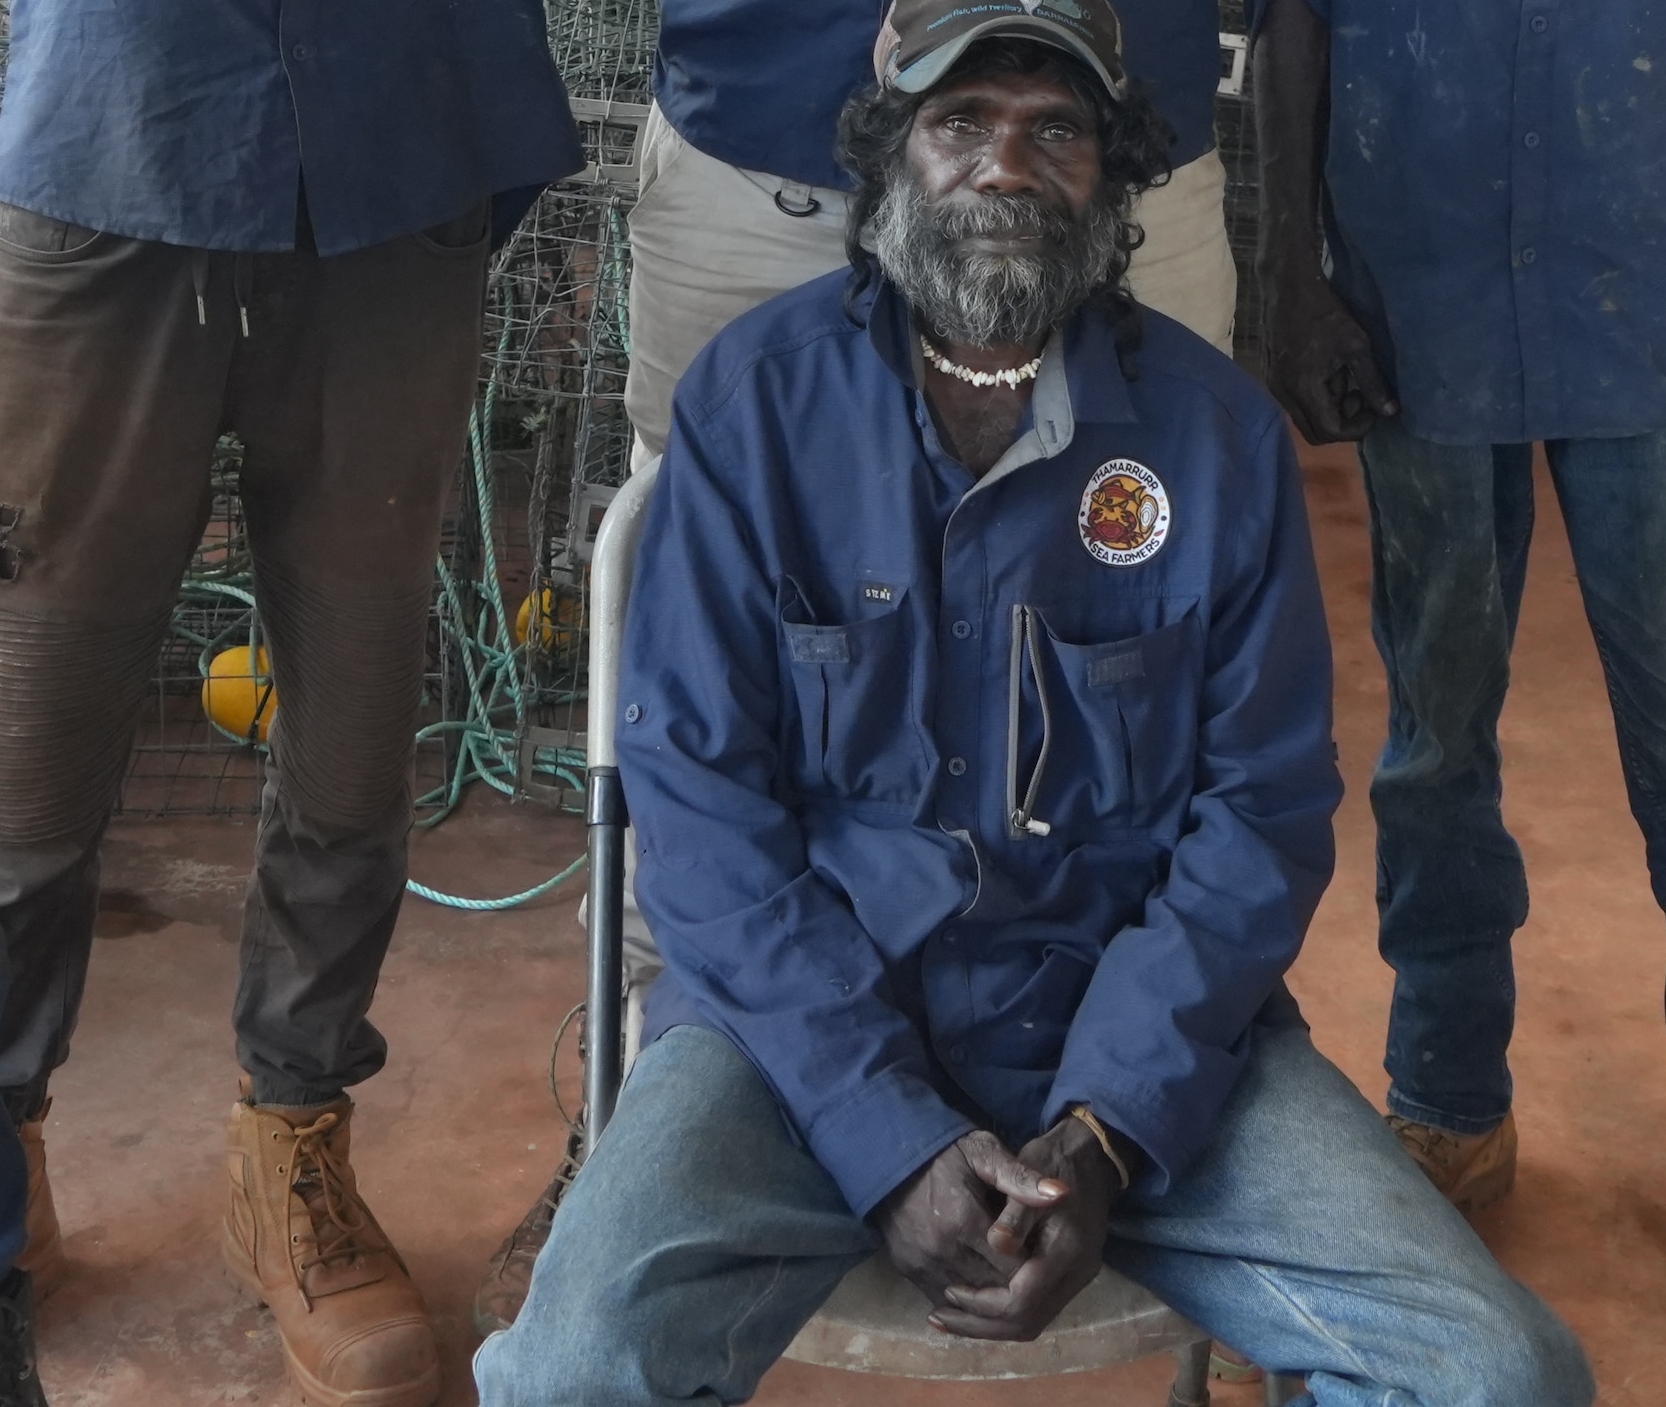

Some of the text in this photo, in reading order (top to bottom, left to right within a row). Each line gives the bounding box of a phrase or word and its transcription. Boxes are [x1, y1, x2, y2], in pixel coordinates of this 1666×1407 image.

[1091, 462, 1159, 491] THAMARRURR
[1091, 538, 1160, 563] SEA FARMERS
